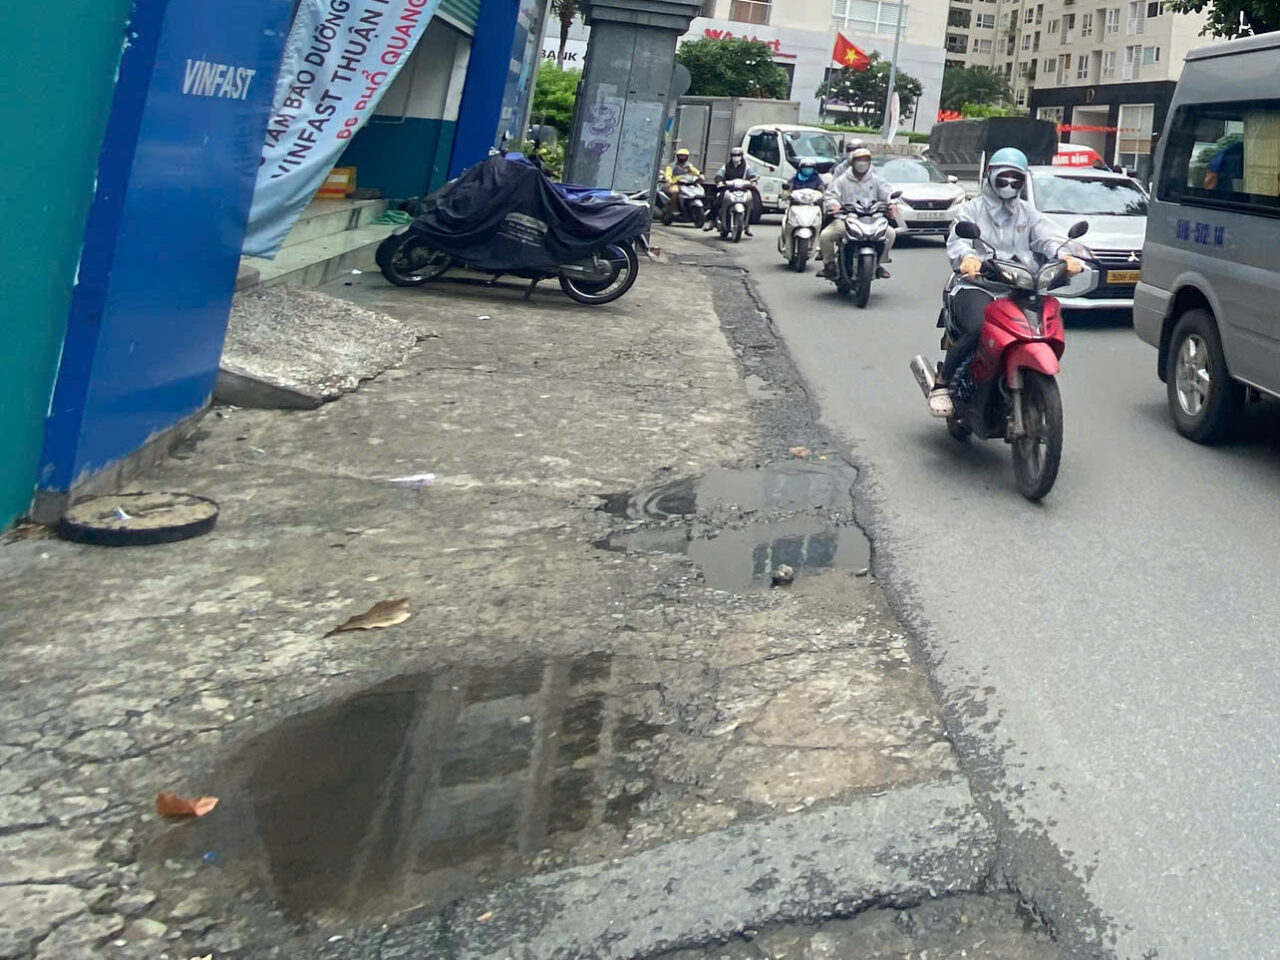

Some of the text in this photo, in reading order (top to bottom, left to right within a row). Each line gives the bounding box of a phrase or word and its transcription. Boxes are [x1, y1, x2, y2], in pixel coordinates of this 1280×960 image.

[182, 59, 257, 101] VINFAST
[271, 88, 343, 180] VINFAST
[330, 8, 384, 83] THUẬN
